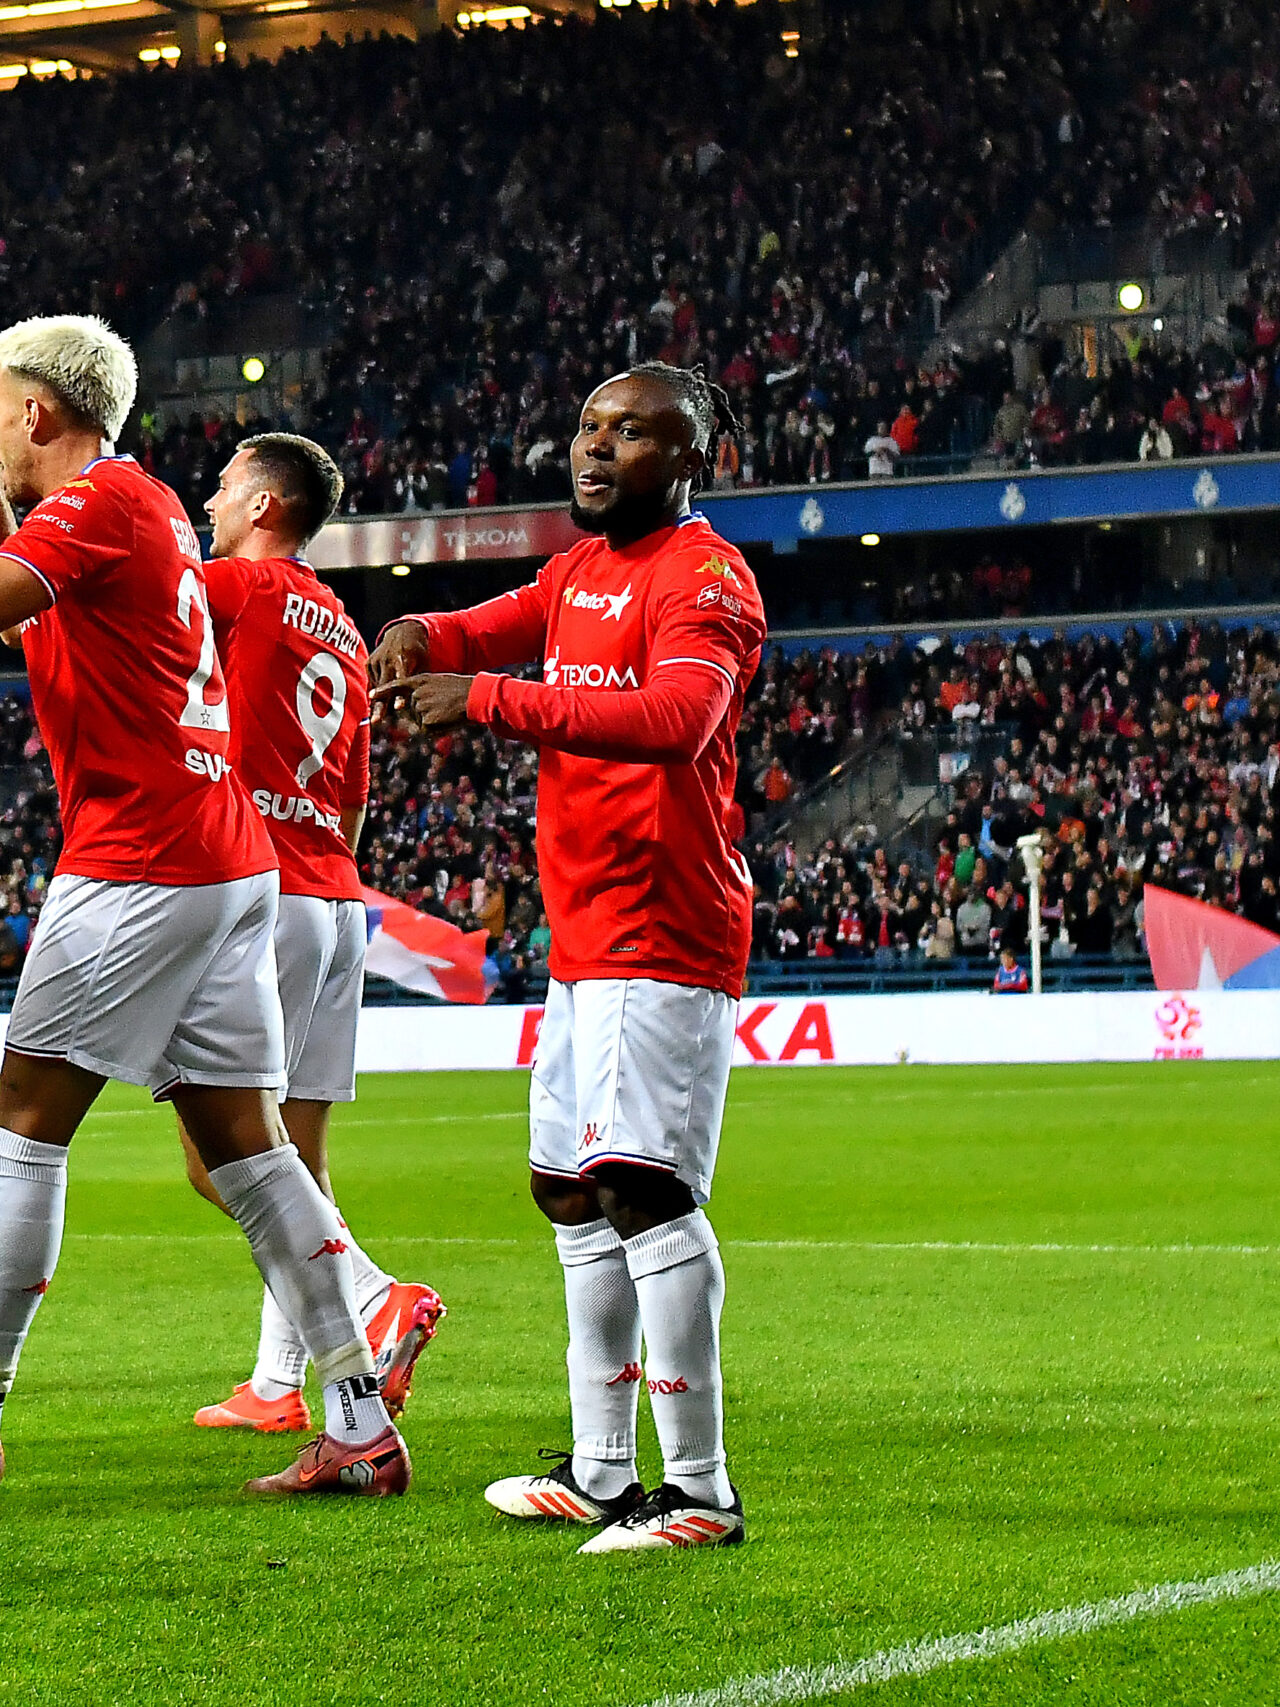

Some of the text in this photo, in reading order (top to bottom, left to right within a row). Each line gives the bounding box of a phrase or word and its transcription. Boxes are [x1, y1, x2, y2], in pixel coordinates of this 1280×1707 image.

[444, 528, 528, 548] TEXOM
[560, 664, 639, 688] TEXOM
[294, 652, 347, 789] 9
